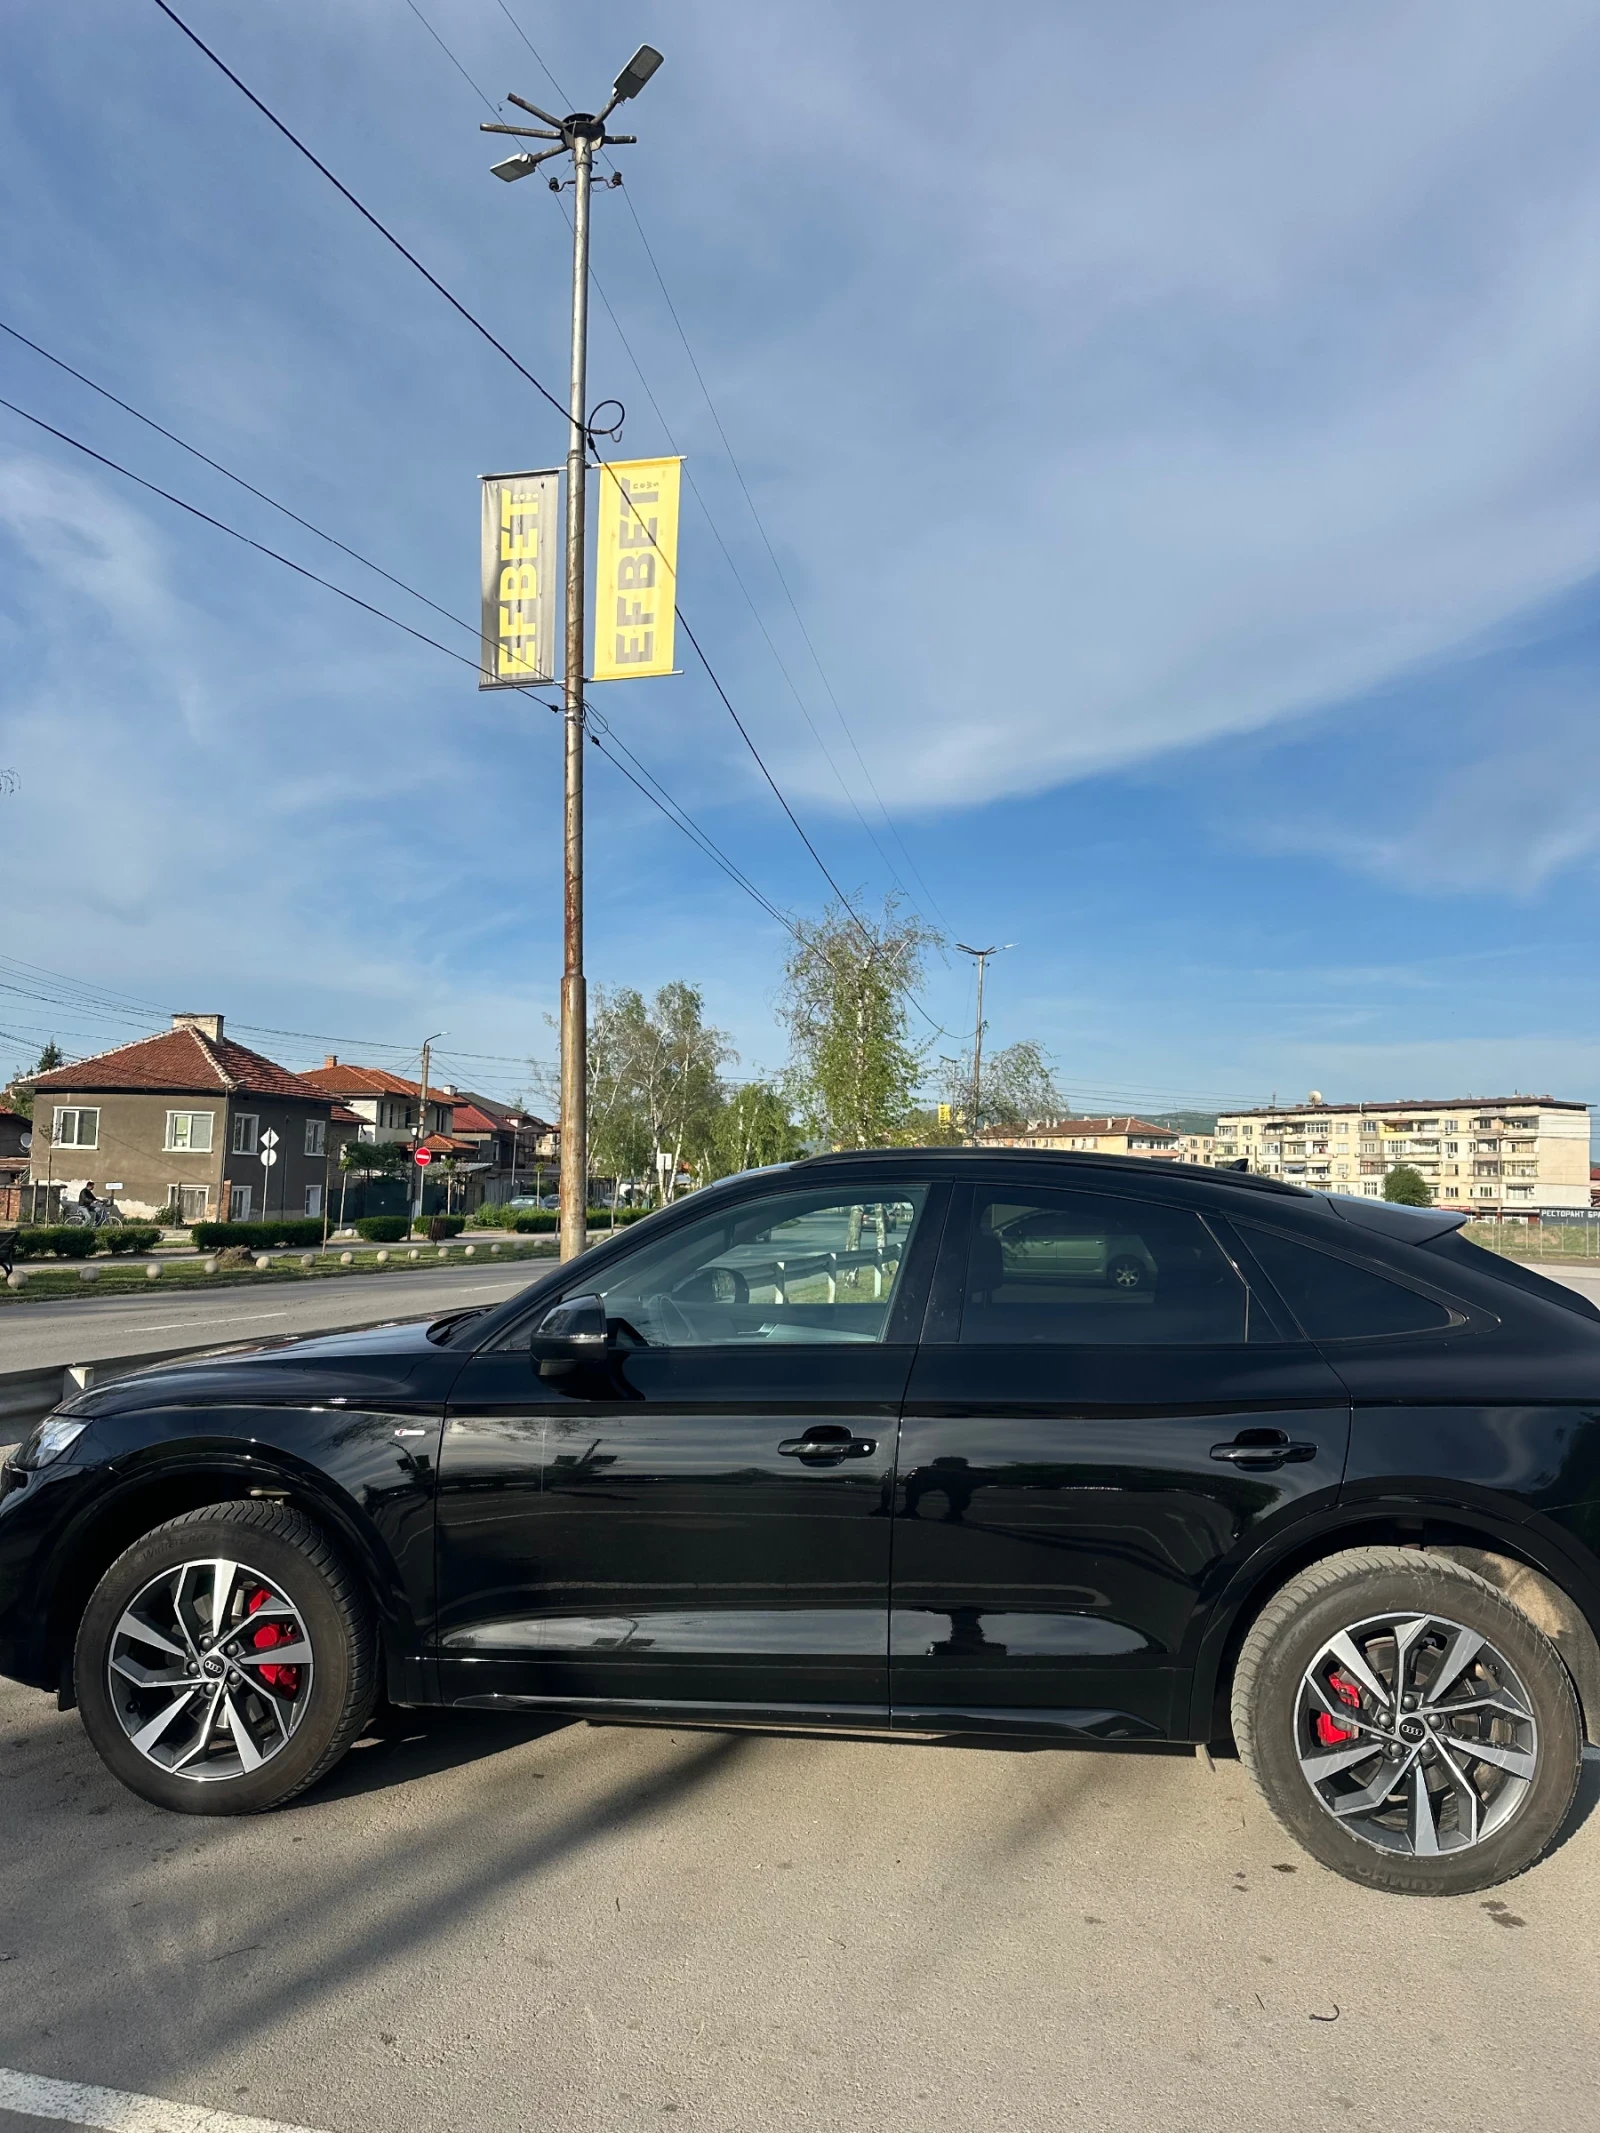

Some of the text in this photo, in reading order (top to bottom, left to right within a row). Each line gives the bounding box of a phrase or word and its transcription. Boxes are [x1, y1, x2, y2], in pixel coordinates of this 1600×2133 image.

[498, 488, 539, 675] EFBET
[615, 477, 659, 665] EFBET
[1541, 1209, 1585, 1218] РЕСТОРАНТ
